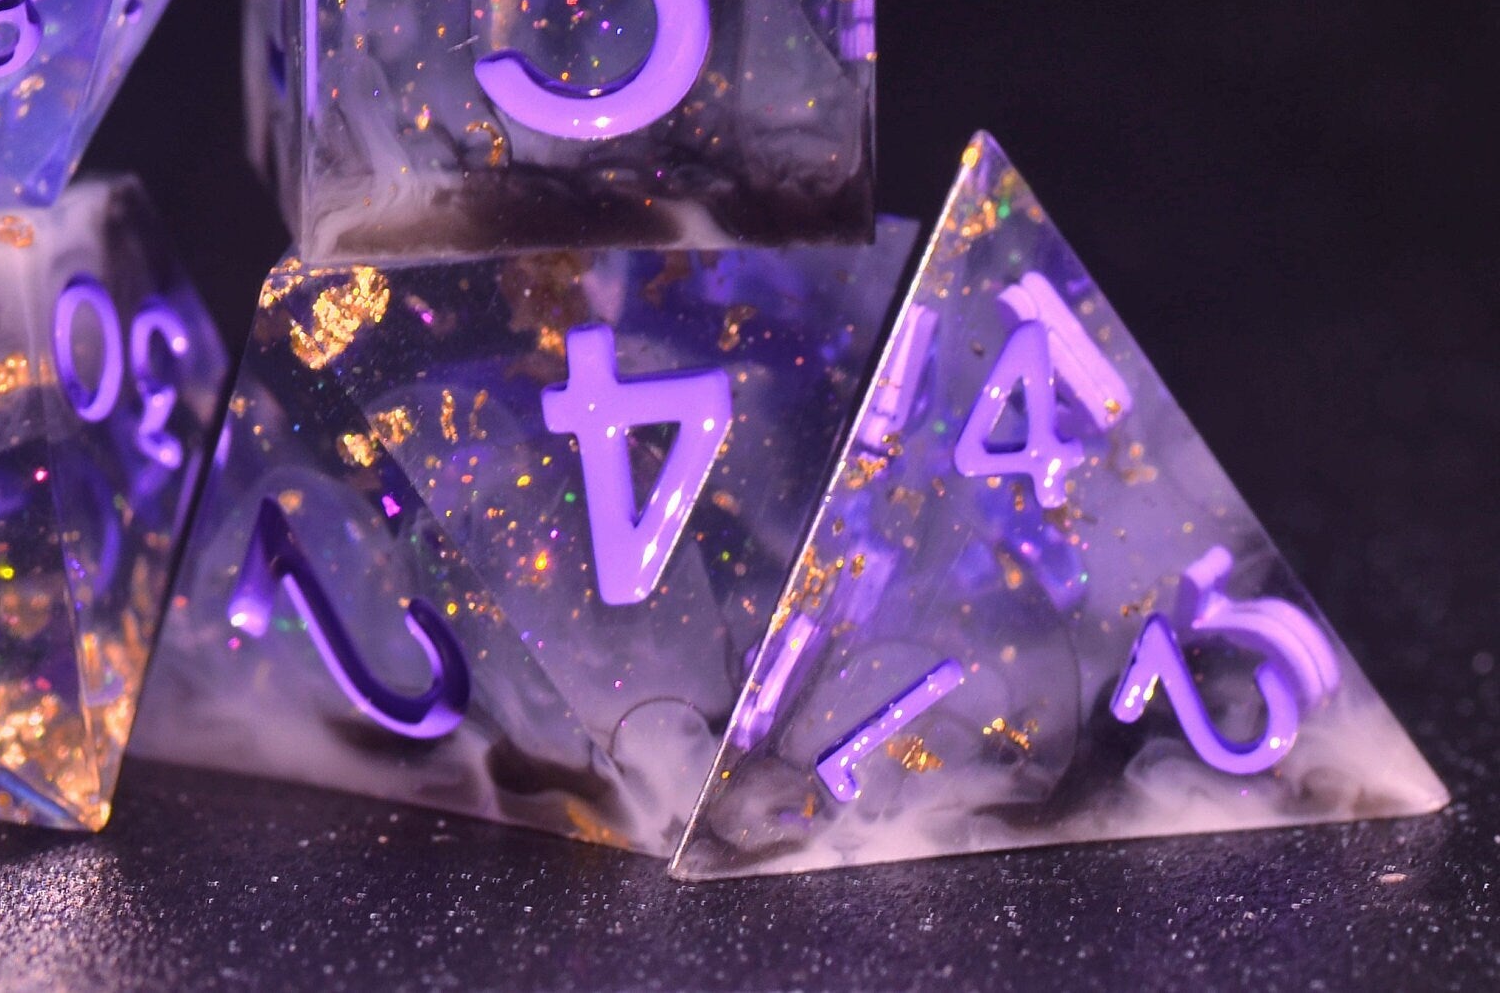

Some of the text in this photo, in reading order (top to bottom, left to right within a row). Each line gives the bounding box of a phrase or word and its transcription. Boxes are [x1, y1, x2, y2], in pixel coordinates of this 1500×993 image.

[54, 272, 191, 469] 30
[542, 323, 732, 606] 4
[953, 319, 1085, 509] 4
[228, 496, 472, 740] 2
[1110, 613, 1299, 775] 2
[815, 658, 966, 803] 1
